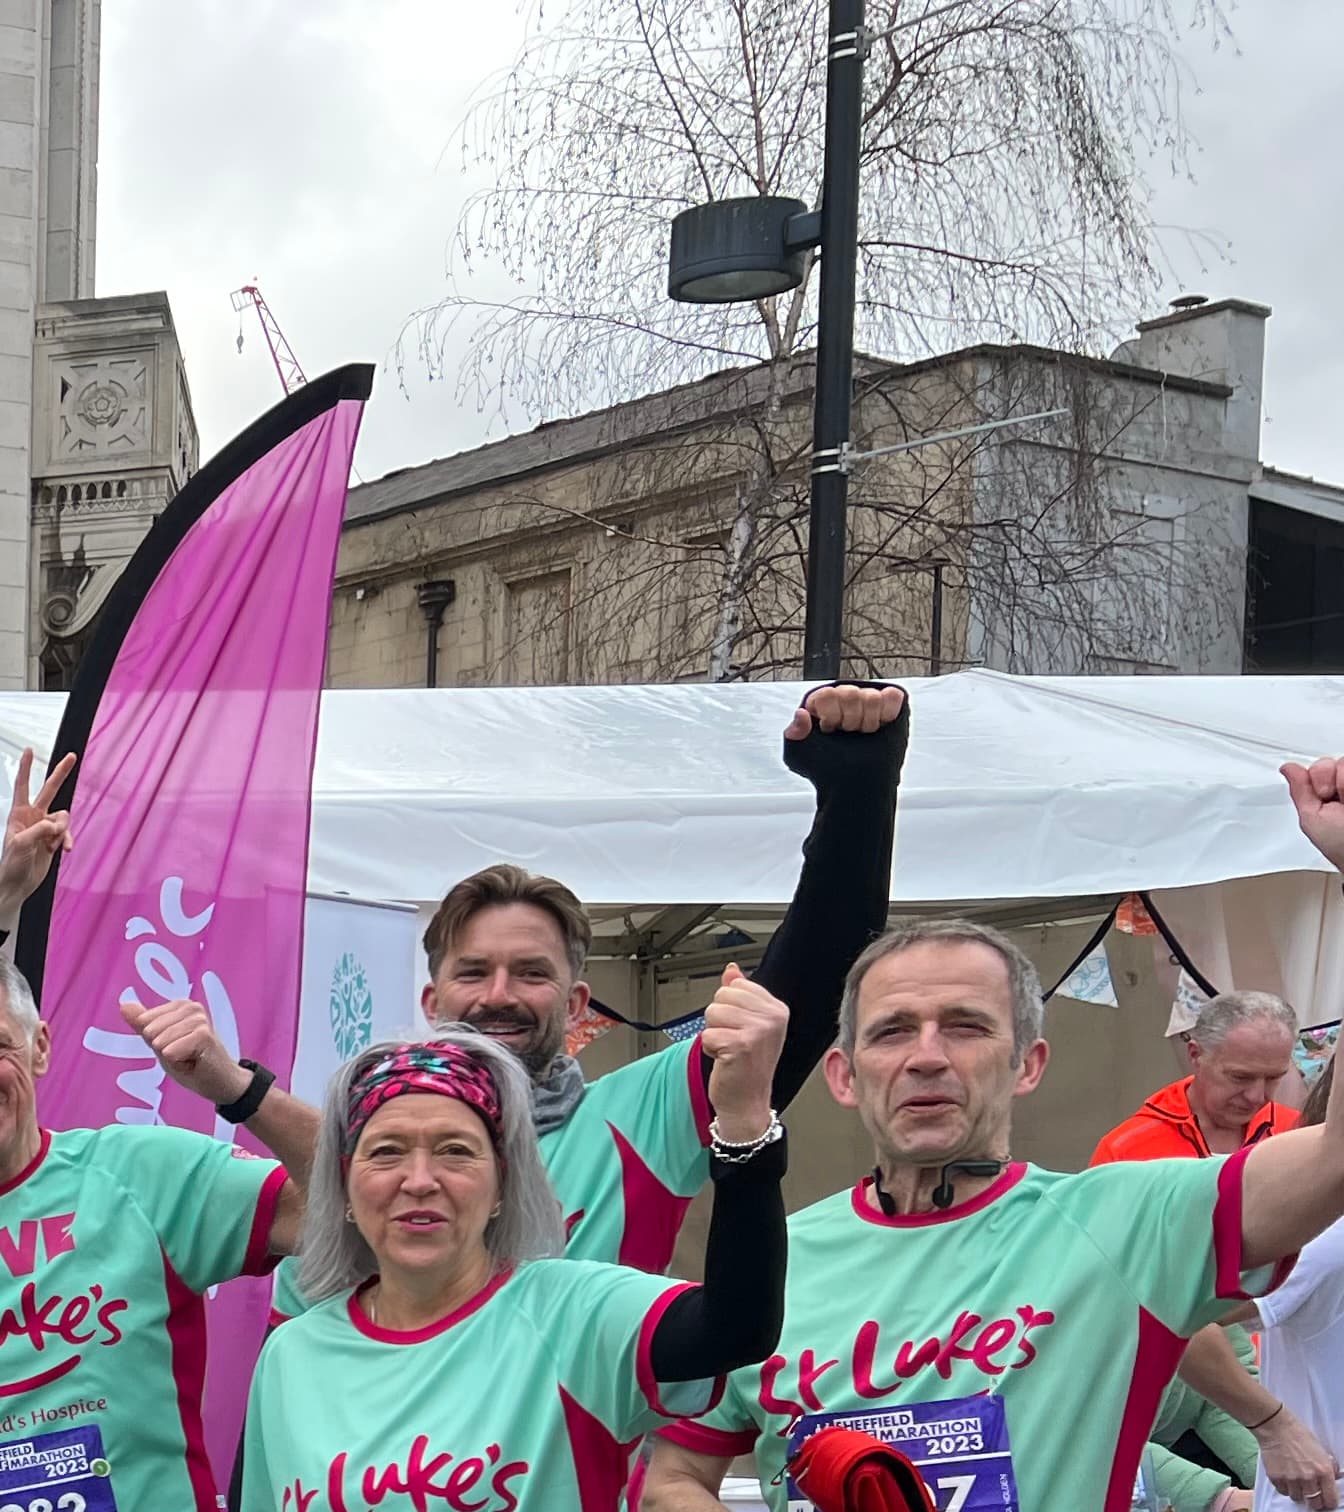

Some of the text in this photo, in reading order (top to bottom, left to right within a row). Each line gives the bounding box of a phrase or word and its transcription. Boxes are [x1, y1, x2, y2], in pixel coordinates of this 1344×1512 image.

[852, 1304, 1056, 1399] Luke's
[31, 1396, 109, 1428] Hospice
[880, 1418, 980, 1442] MARATHON
[10, 1444, 85, 1470] MARATHON
[926, 1433, 984, 1456] 2023
[44, 1456, 90, 1479] 2023
